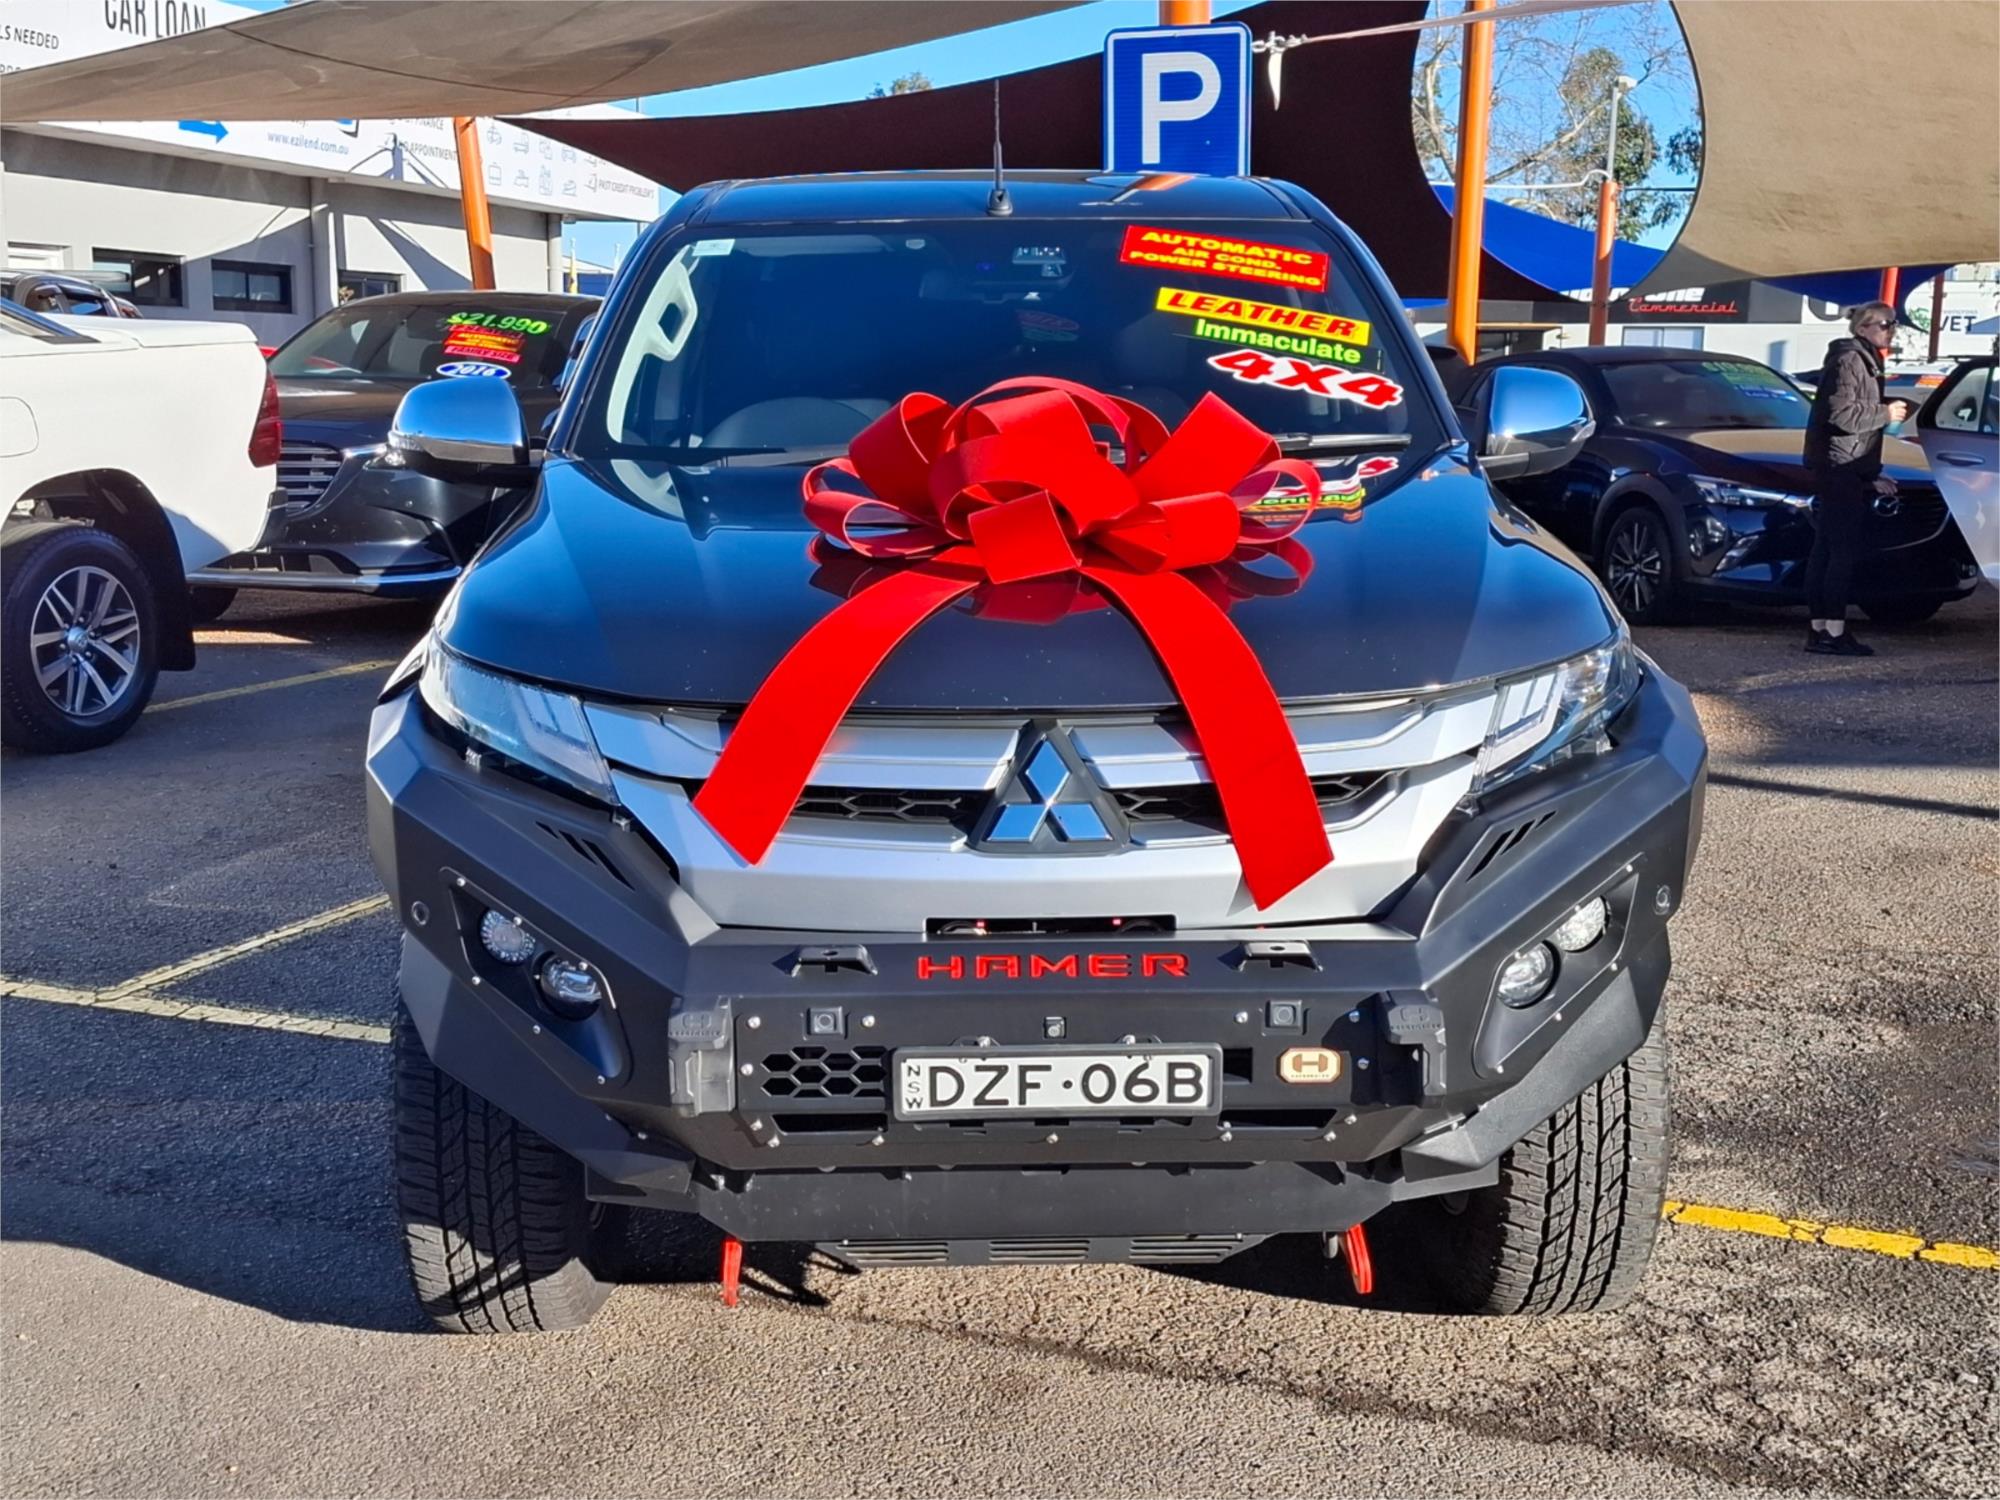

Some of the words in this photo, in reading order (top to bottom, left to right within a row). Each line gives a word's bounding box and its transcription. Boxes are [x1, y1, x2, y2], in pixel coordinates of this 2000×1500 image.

[105, 0, 146, 37] CAR
[14, 27, 60, 50] NEEDED
[1142, 51, 1222, 164] P
[1141, 231, 1312, 265] AUTOMATIC
[1172, 247, 1210, 259] AIR
[1215, 253, 1282, 270] COND.
[1130, 251, 1207, 268] POWER
[1212, 262, 1321, 286] STEERING
[1168, 292, 1357, 337] LEATHER
[1628, 297, 1738, 314] Commercial
[1195, 318, 1361, 364] Immaculate
[917, 953, 1189, 980] HAMER
[906, 1064, 924, 1109] NSW
